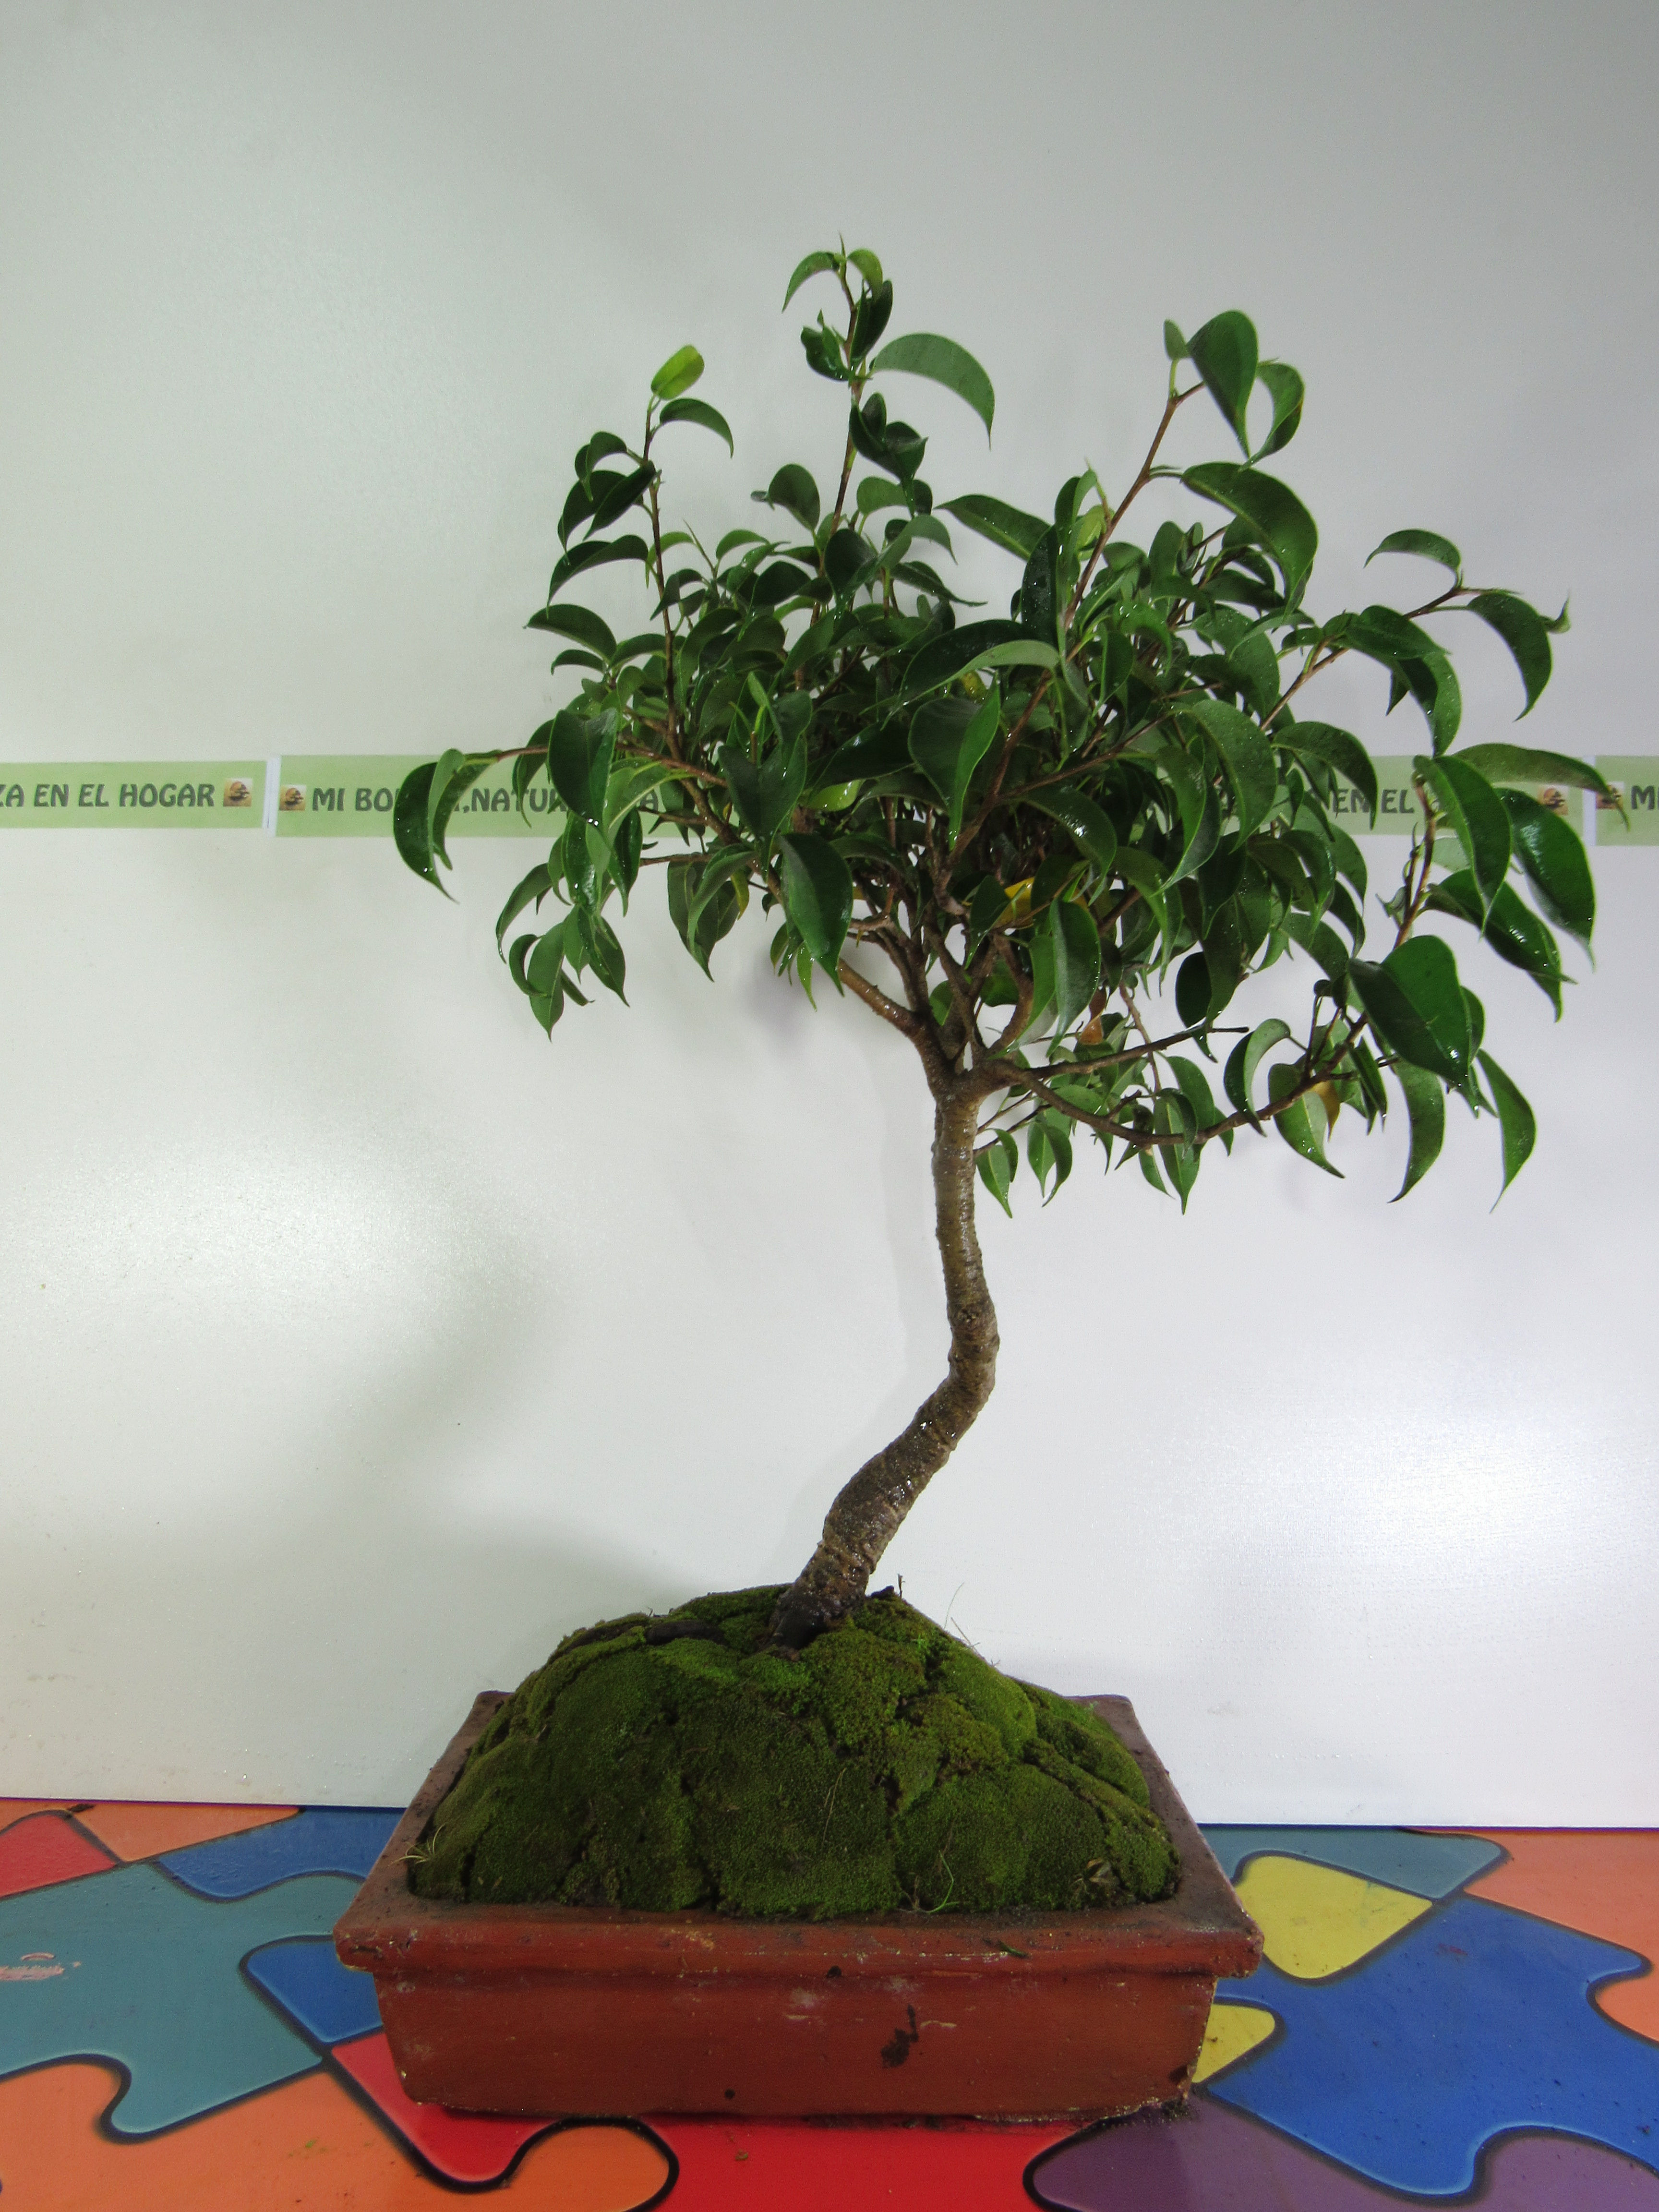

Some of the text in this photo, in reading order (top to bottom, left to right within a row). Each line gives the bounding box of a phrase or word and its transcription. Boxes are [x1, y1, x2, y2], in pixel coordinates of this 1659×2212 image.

[34, 783, 69, 807] EN
[78, 783, 109, 807] EL
[119, 783, 215, 807] HOGAR
[312, 788, 345, 811] MI
[1381, 789, 1415, 813] EL
[1631, 785, 1659, 810] M
